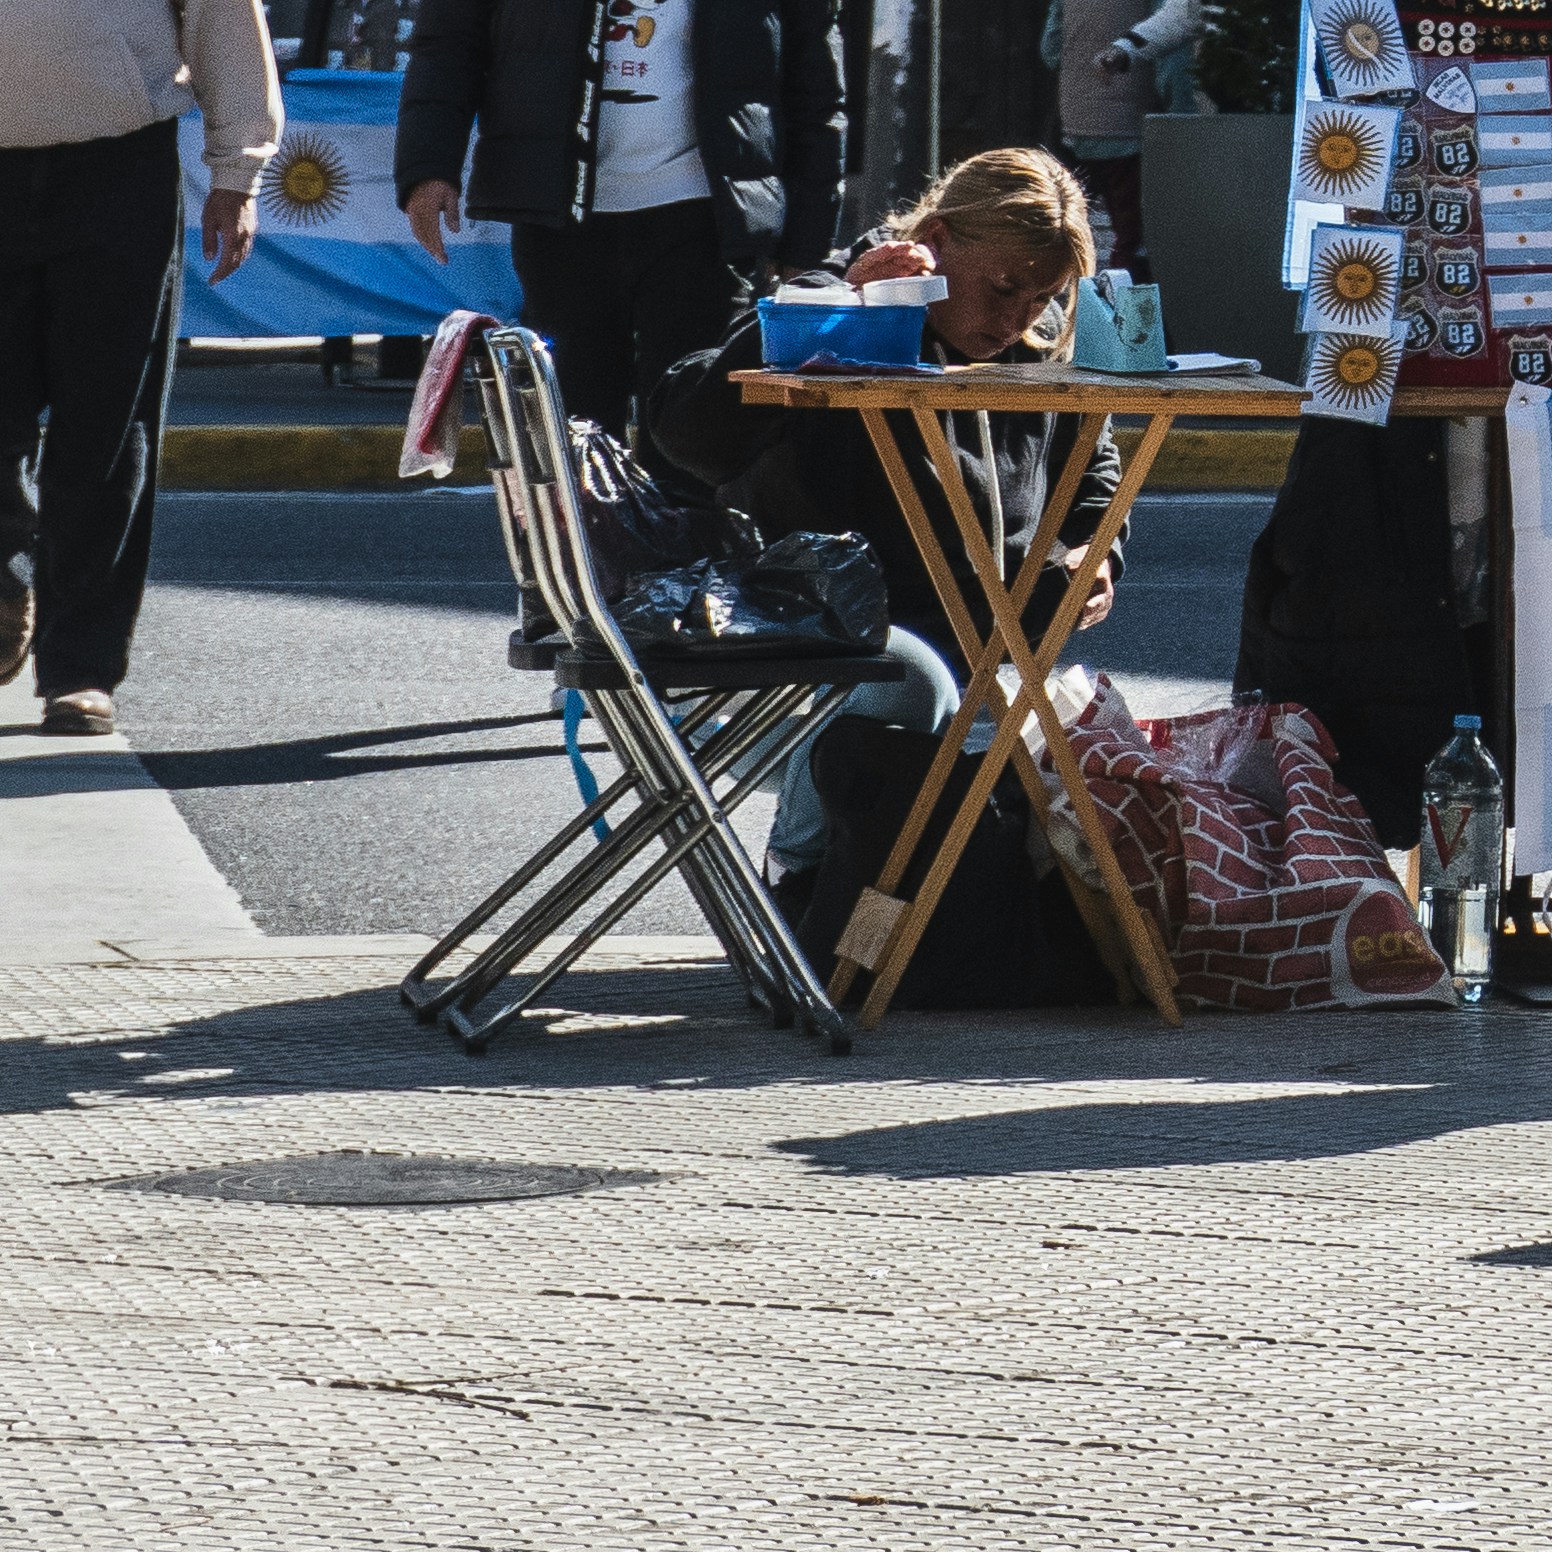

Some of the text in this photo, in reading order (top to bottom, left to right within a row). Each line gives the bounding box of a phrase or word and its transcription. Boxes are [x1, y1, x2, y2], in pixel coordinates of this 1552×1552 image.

[1441, 143, 1471, 165] 82
[1390, 192, 1417, 213] 82
[1434, 202, 1462, 224] 82
[1443, 264, 1471, 284] 82
[1447, 323, 1475, 344] 82
[1518, 352, 1545, 374] 82
